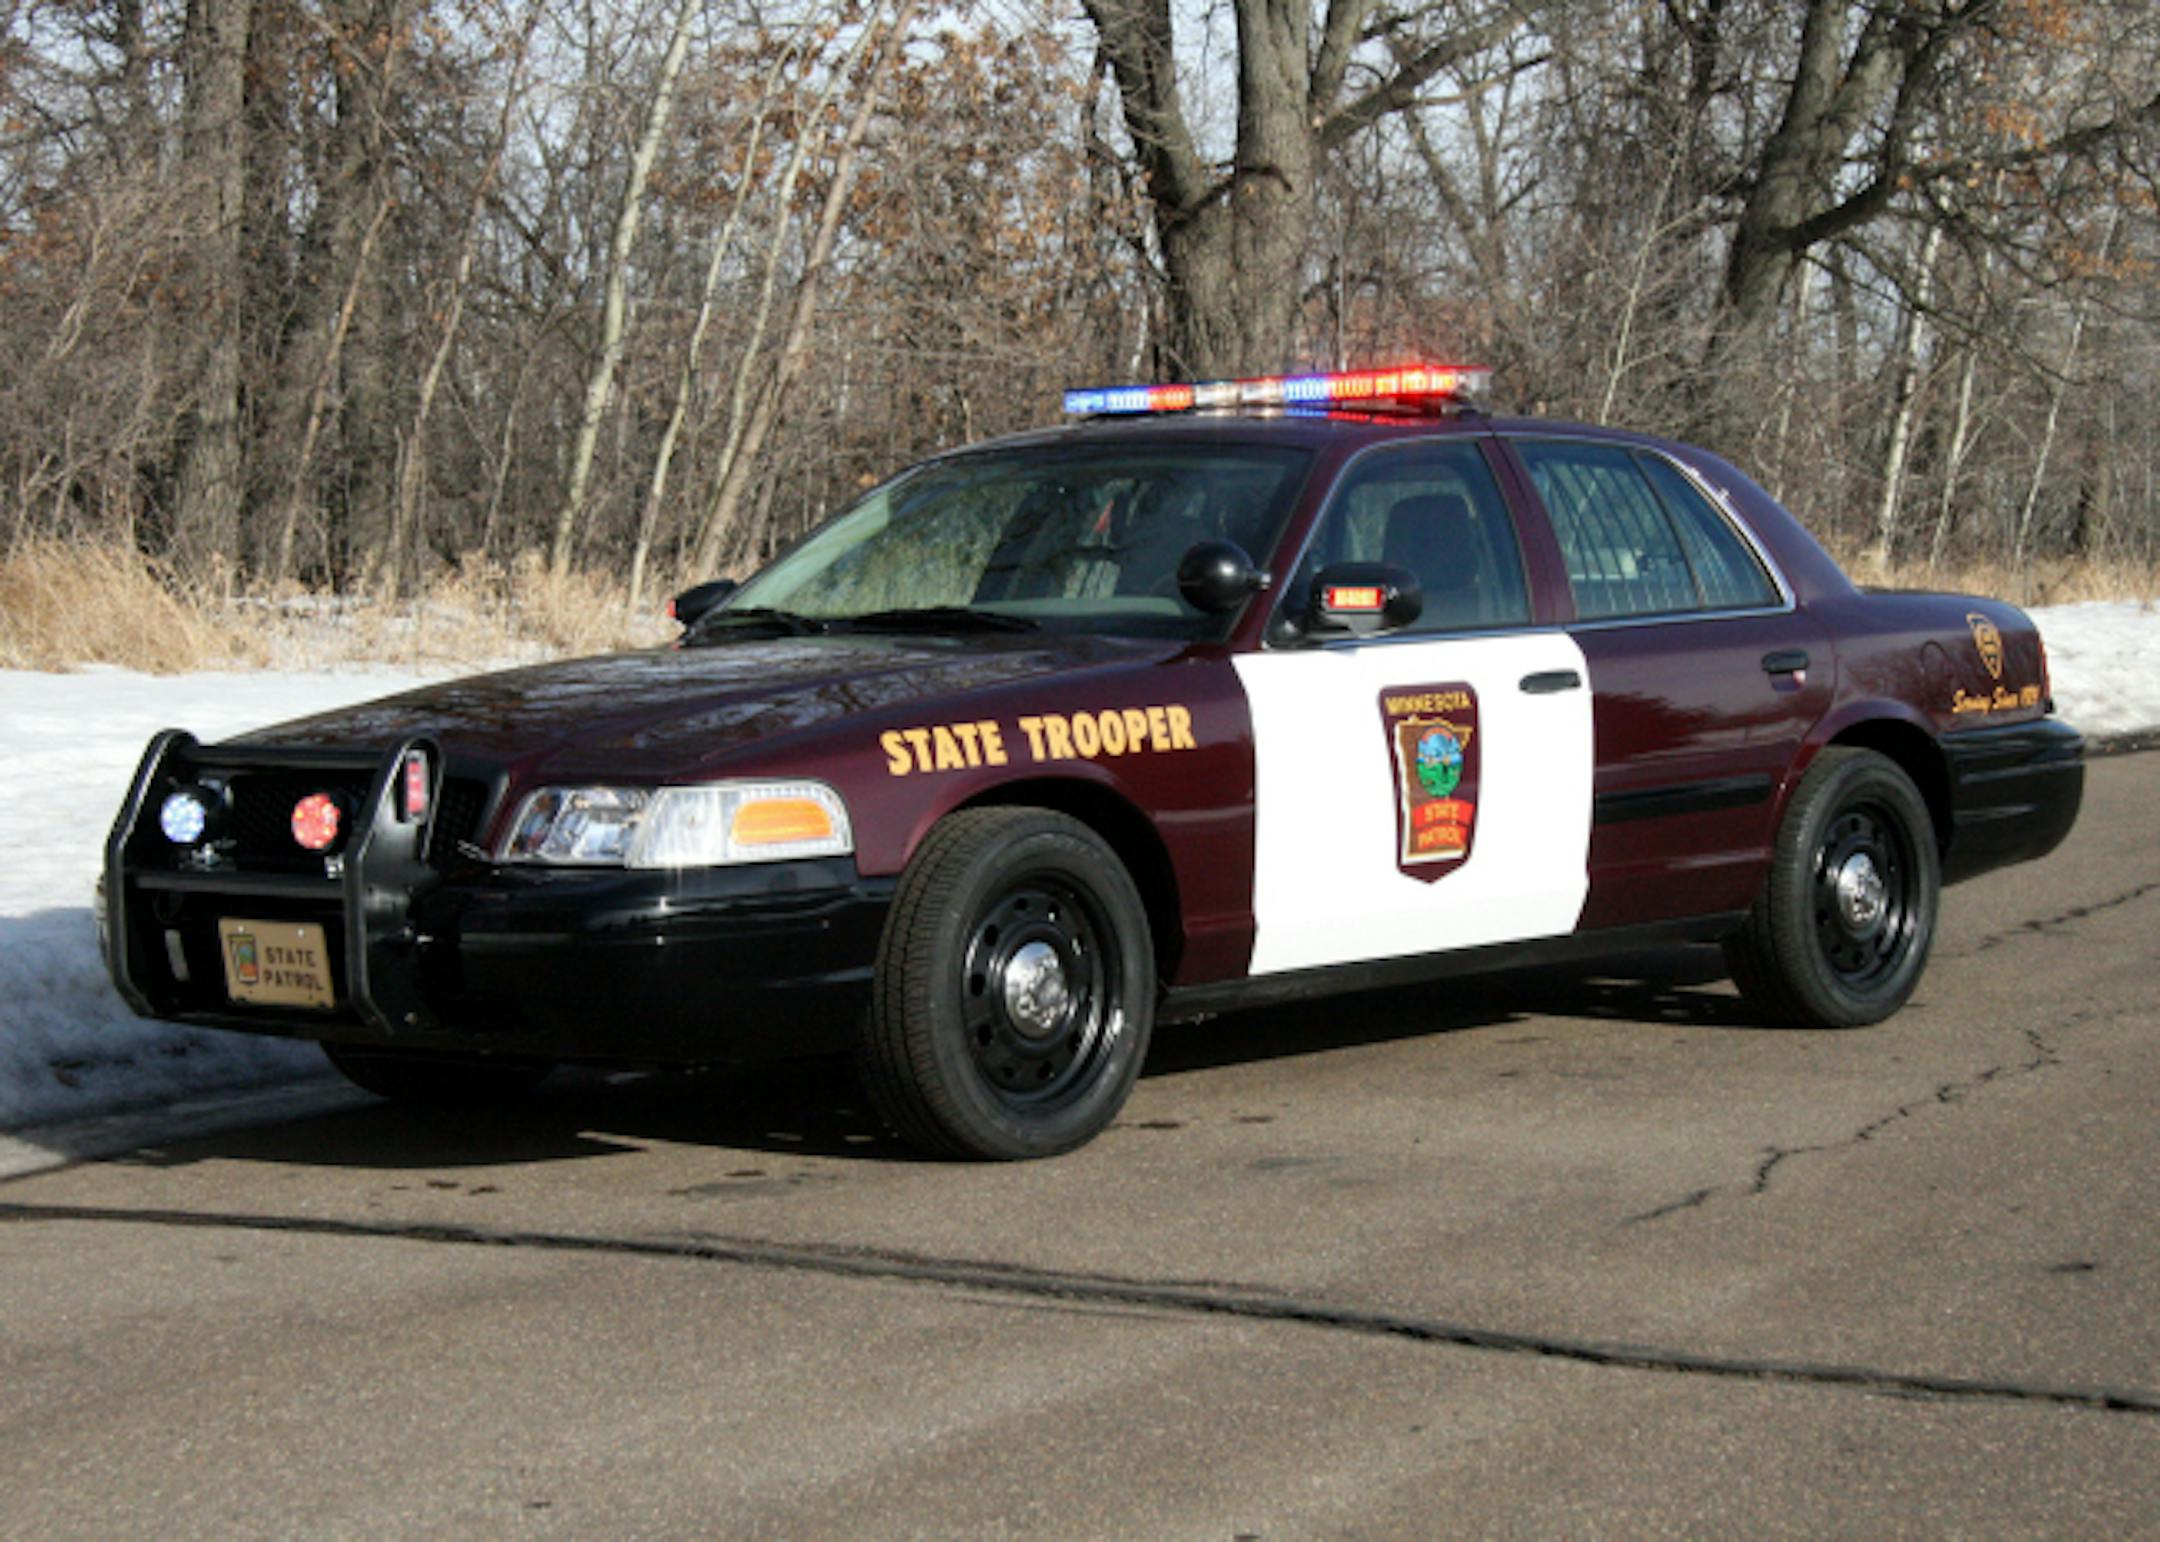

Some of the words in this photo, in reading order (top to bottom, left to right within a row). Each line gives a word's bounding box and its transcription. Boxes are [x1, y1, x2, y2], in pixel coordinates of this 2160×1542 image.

[880, 719, 1008, 776] STATE
[1018, 704, 1198, 762] TROOPER
[1423, 802, 1460, 822] STATE
[1417, 826, 1464, 848] PATROL
[265, 946, 316, 968] STATE
[264, 969, 324, 991] PATROL
